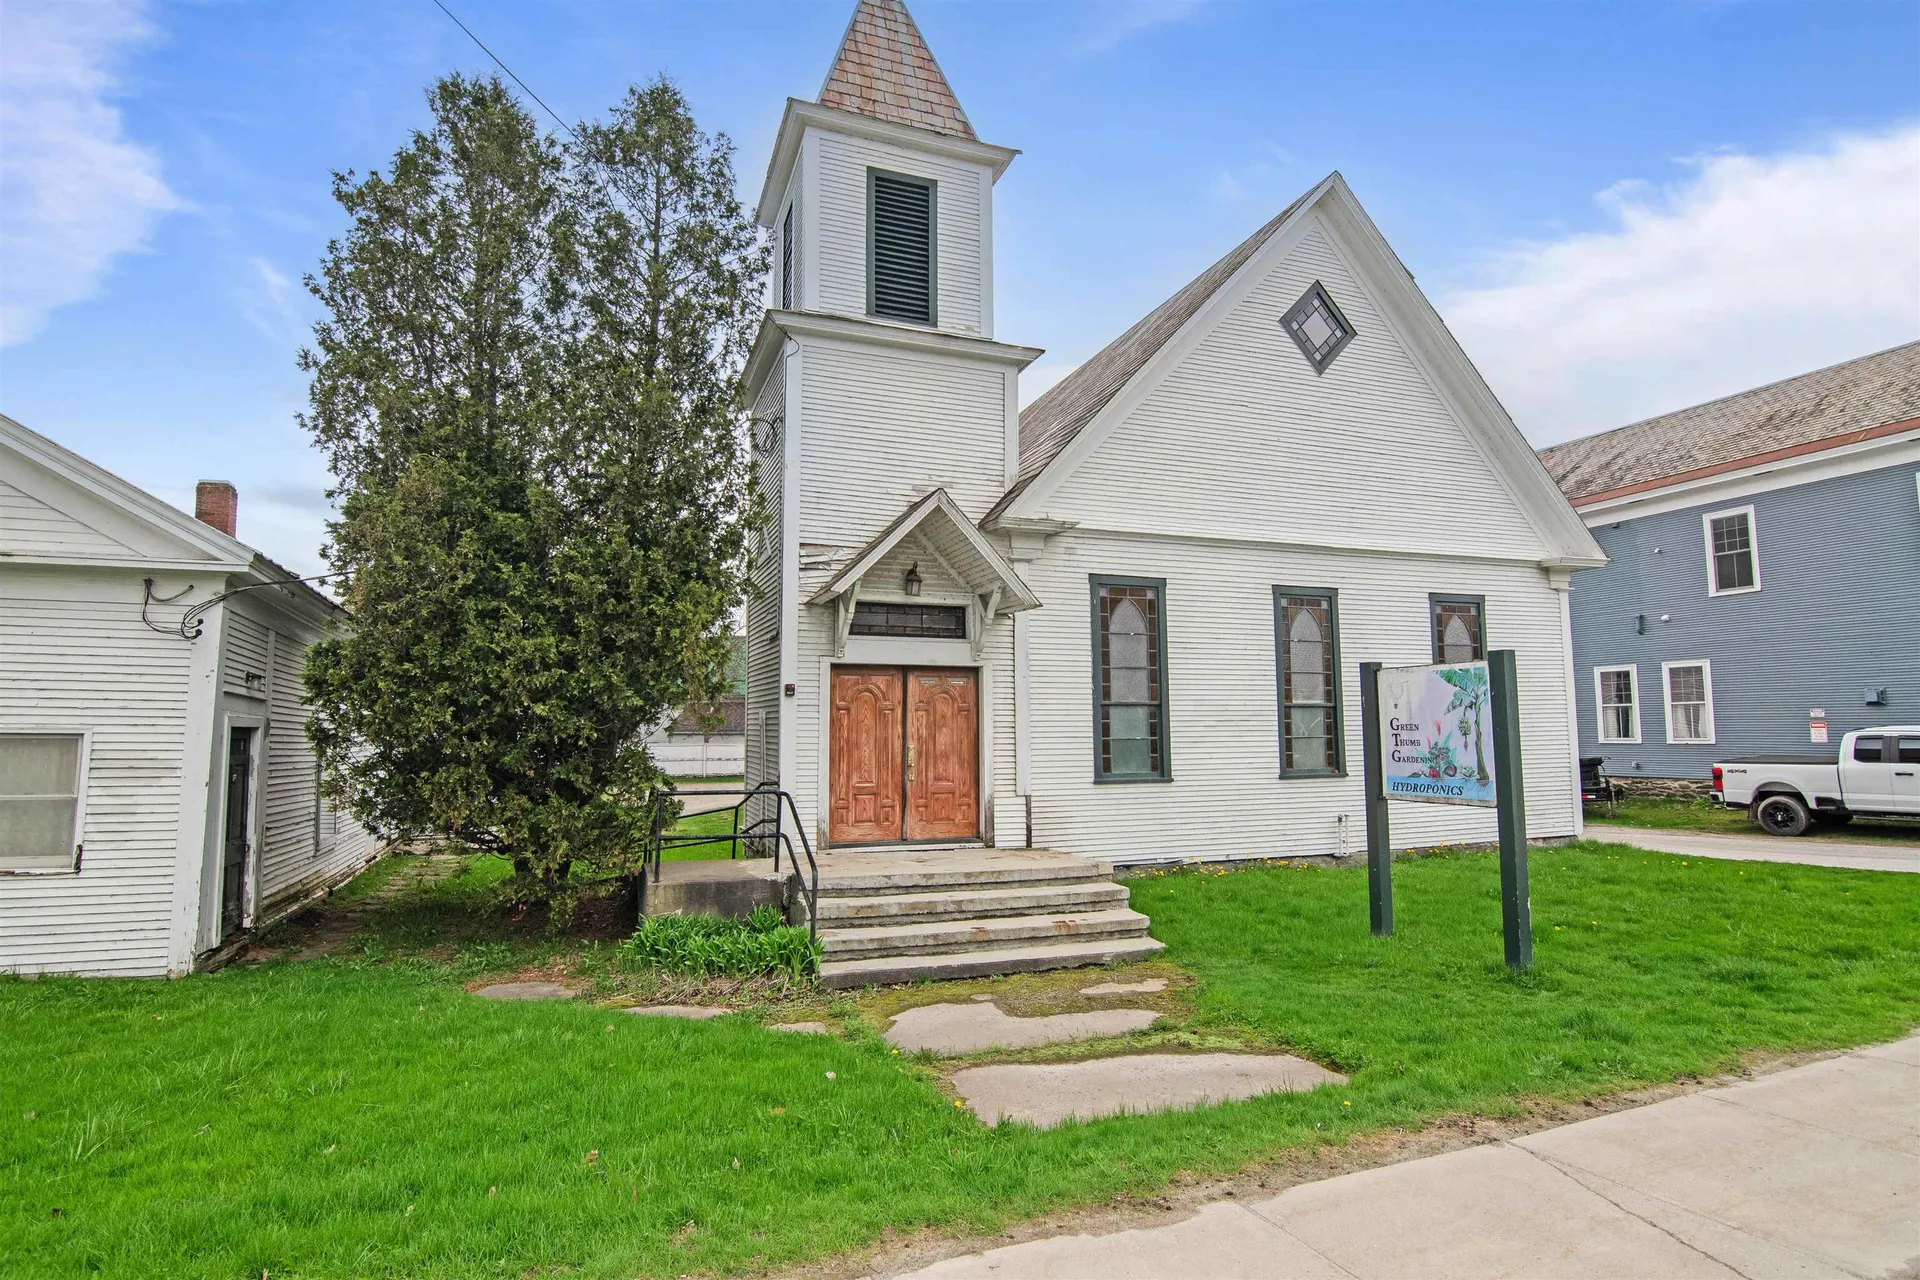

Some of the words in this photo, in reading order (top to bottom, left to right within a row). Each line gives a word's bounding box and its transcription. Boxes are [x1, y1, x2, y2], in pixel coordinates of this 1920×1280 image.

[1390, 717, 1420, 731] GREEN
[1391, 733, 1421, 747] THUMB
[1391, 749, 1438, 764] GARDENING
[1392, 782, 1464, 796] HYDROPONICS
